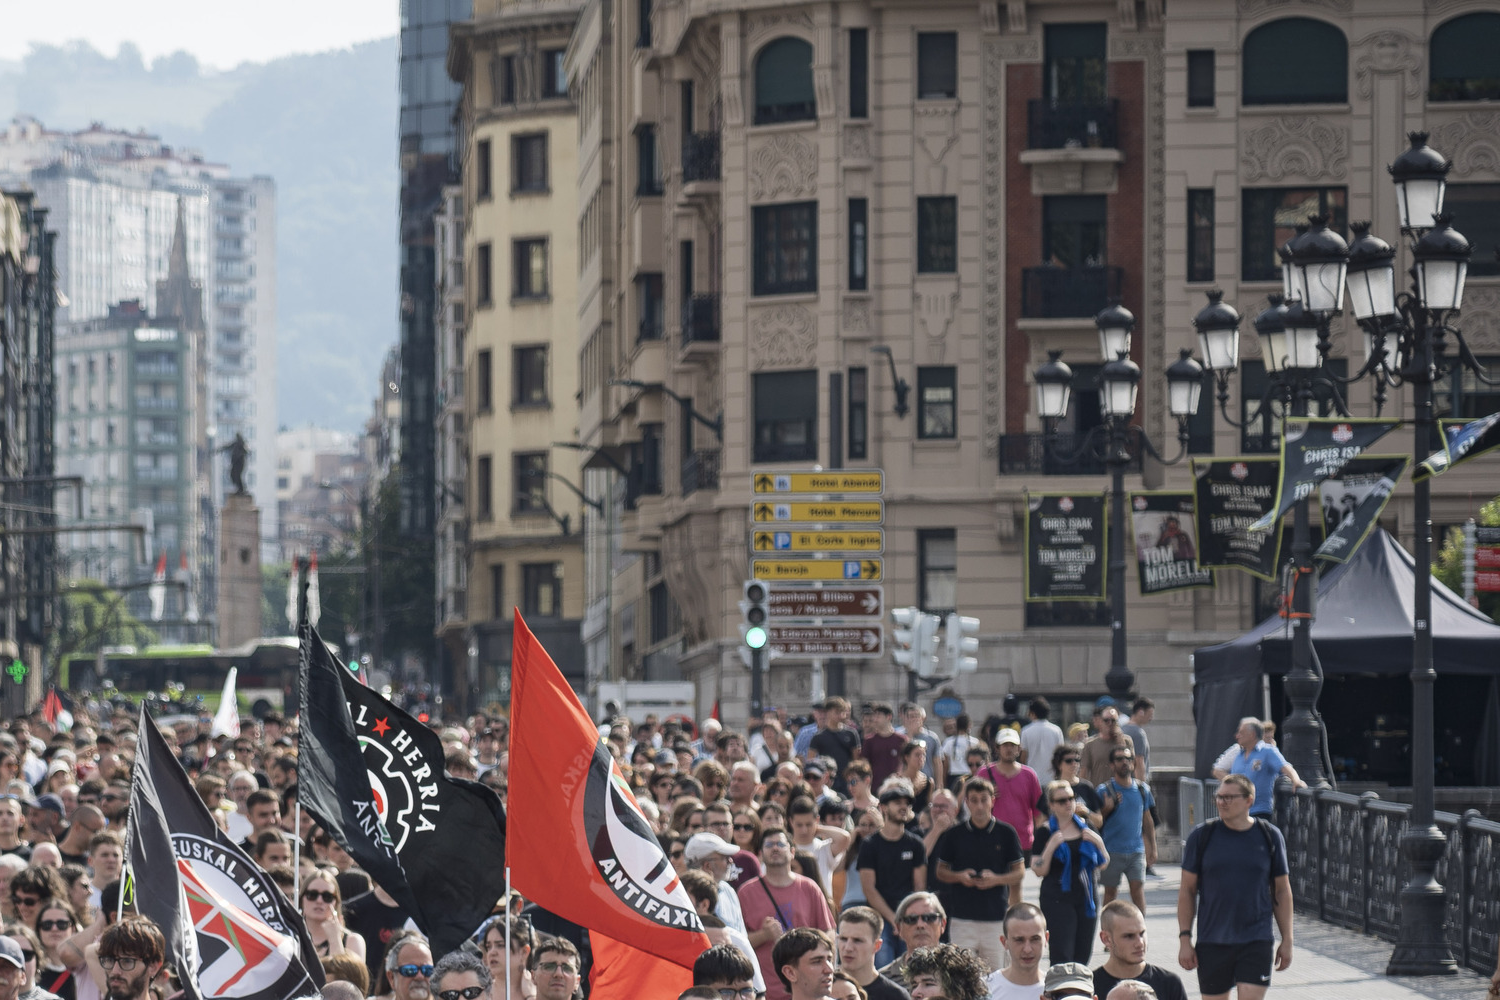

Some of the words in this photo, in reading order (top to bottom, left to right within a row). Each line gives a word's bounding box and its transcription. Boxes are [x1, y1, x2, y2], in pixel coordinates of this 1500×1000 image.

[1143, 545, 1174, 565] TOM
[391, 729, 441, 833] HERRIA
[172, 839, 237, 879] EUSKAL
[242, 877, 284, 932] HERR
